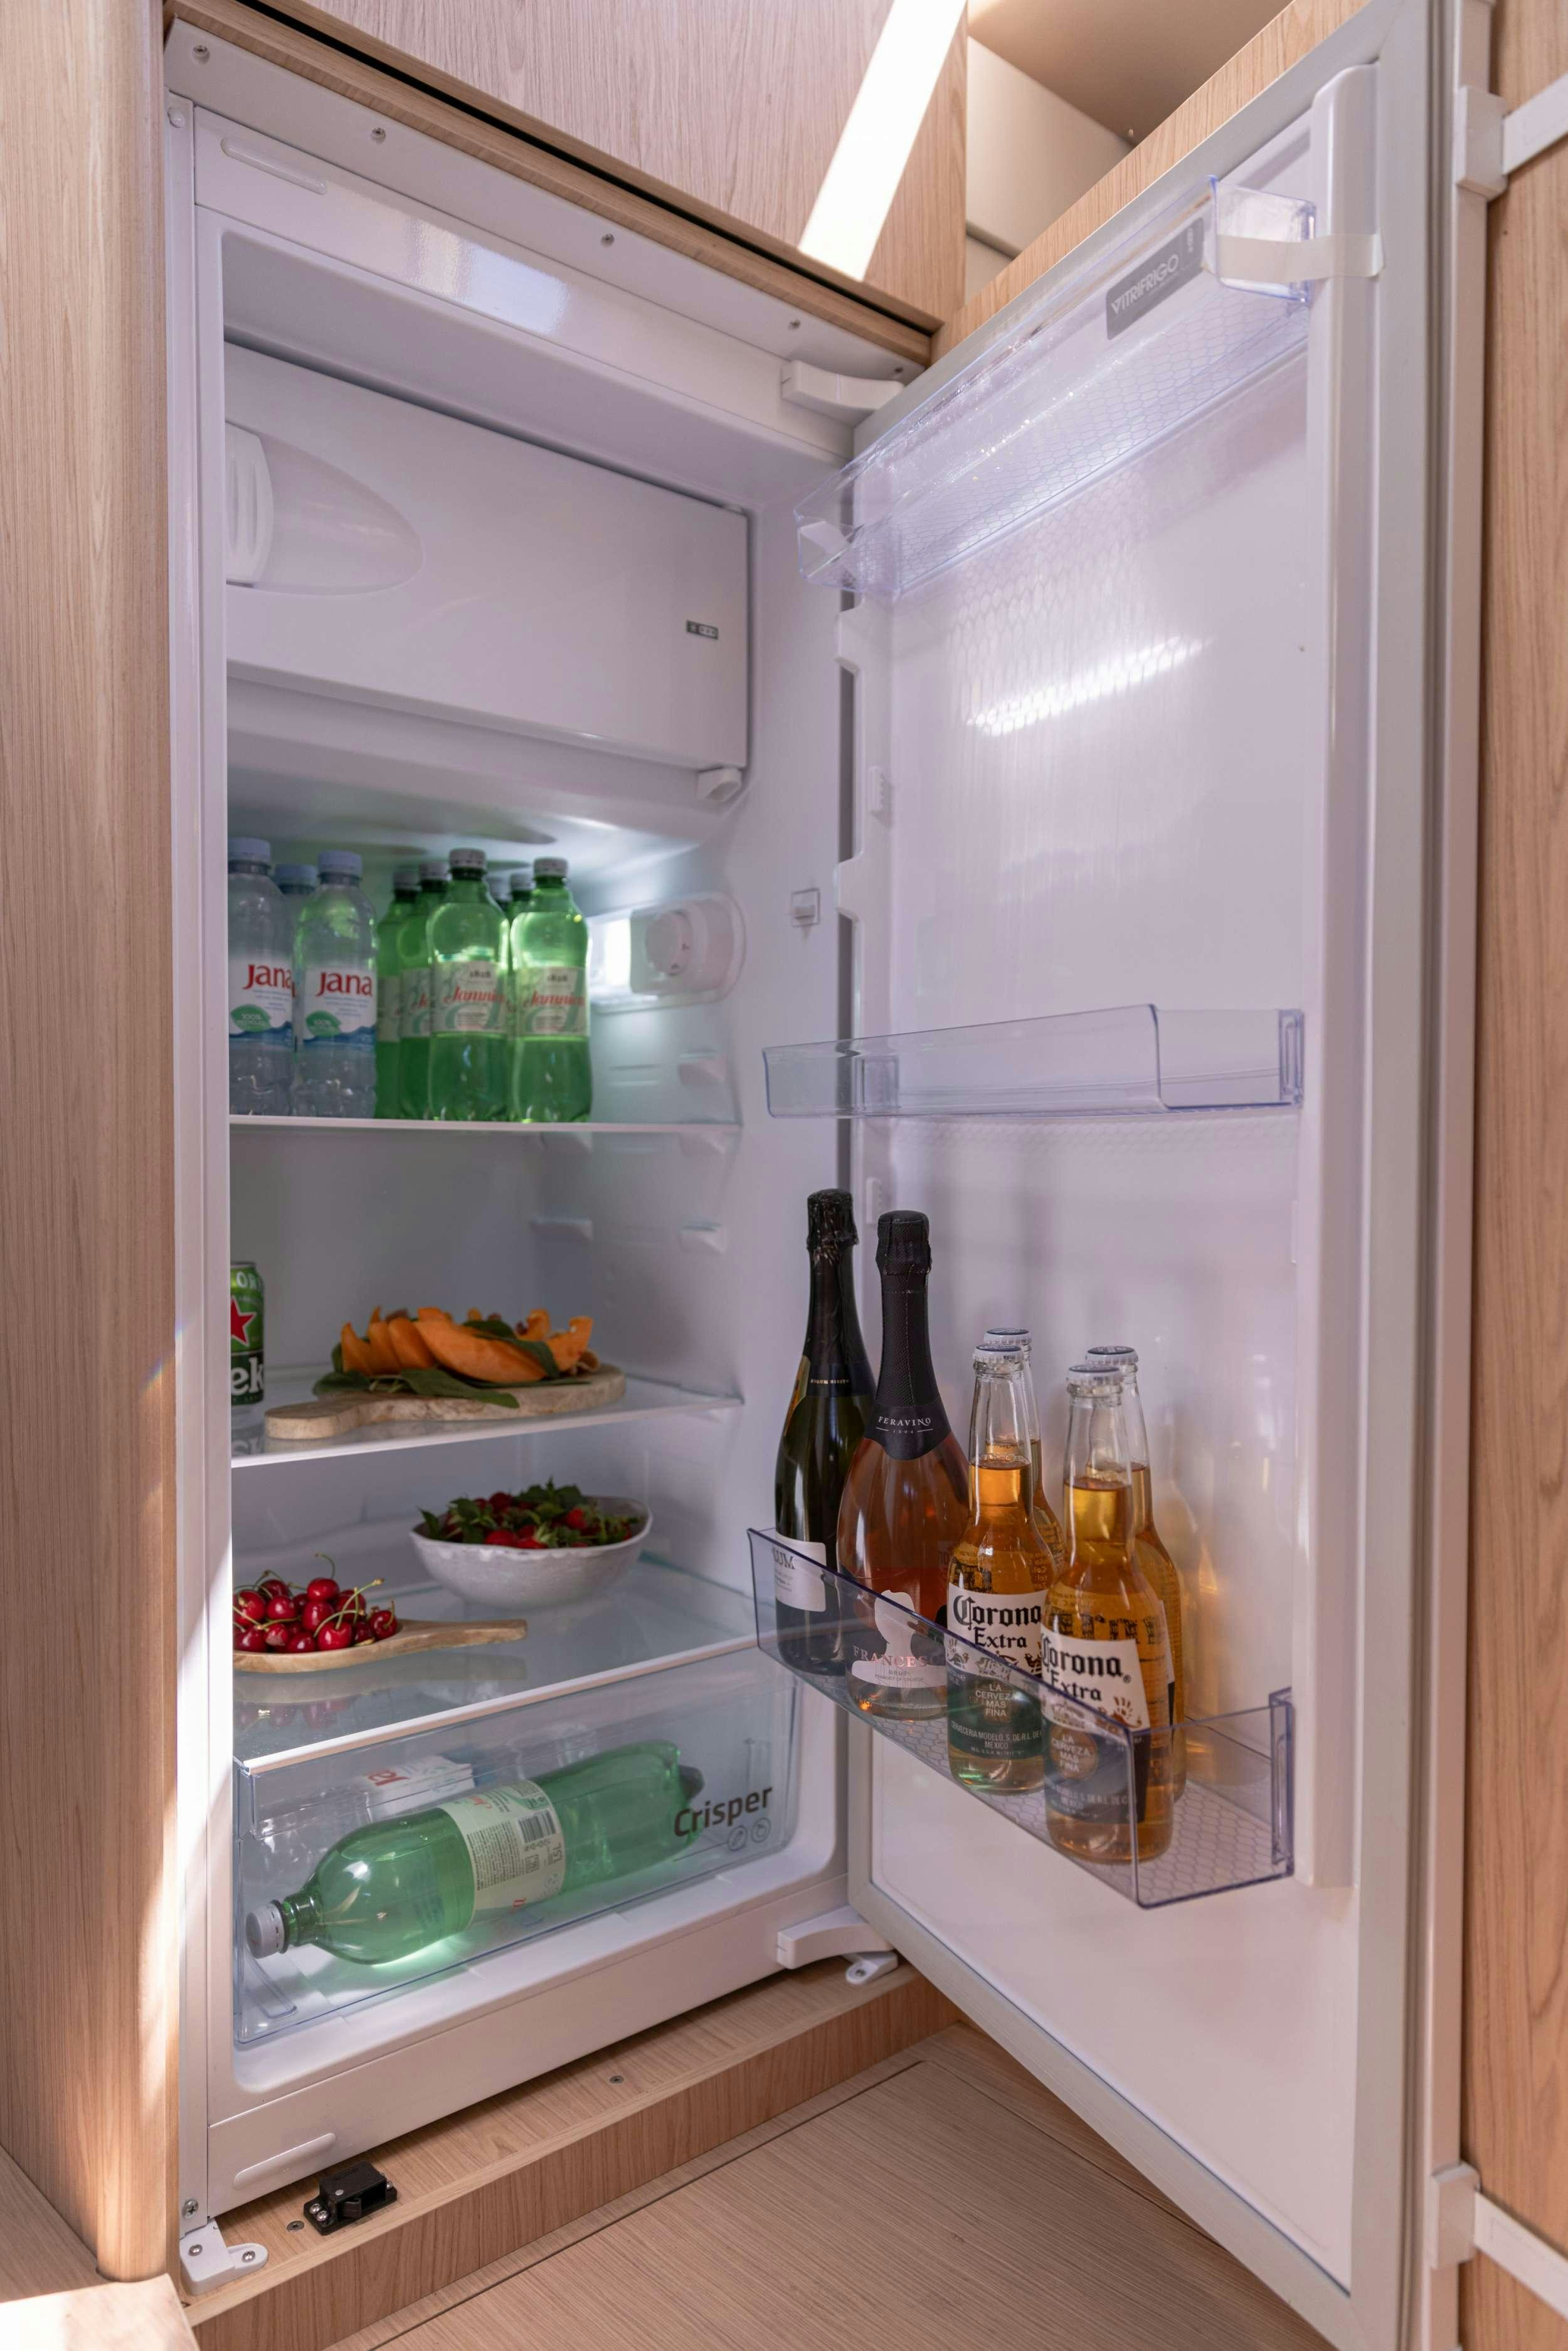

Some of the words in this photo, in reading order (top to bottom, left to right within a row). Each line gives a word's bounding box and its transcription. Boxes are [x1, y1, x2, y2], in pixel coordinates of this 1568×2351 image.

[1110, 254, 1179, 314] VITRIFRIGO
[316, 972, 373, 997] Jana
[878, 1416, 931, 1427] FERAVINO
[953, 1595, 1041, 1631] Corona
[973, 1627, 1027, 1648] Extra
[1041, 1633, 1123, 1678] Corona
[1049, 1669, 1101, 1701] Extra
[985, 1709, 1007, 1717] FINA
[674, 1787, 773, 1837] Crisper
